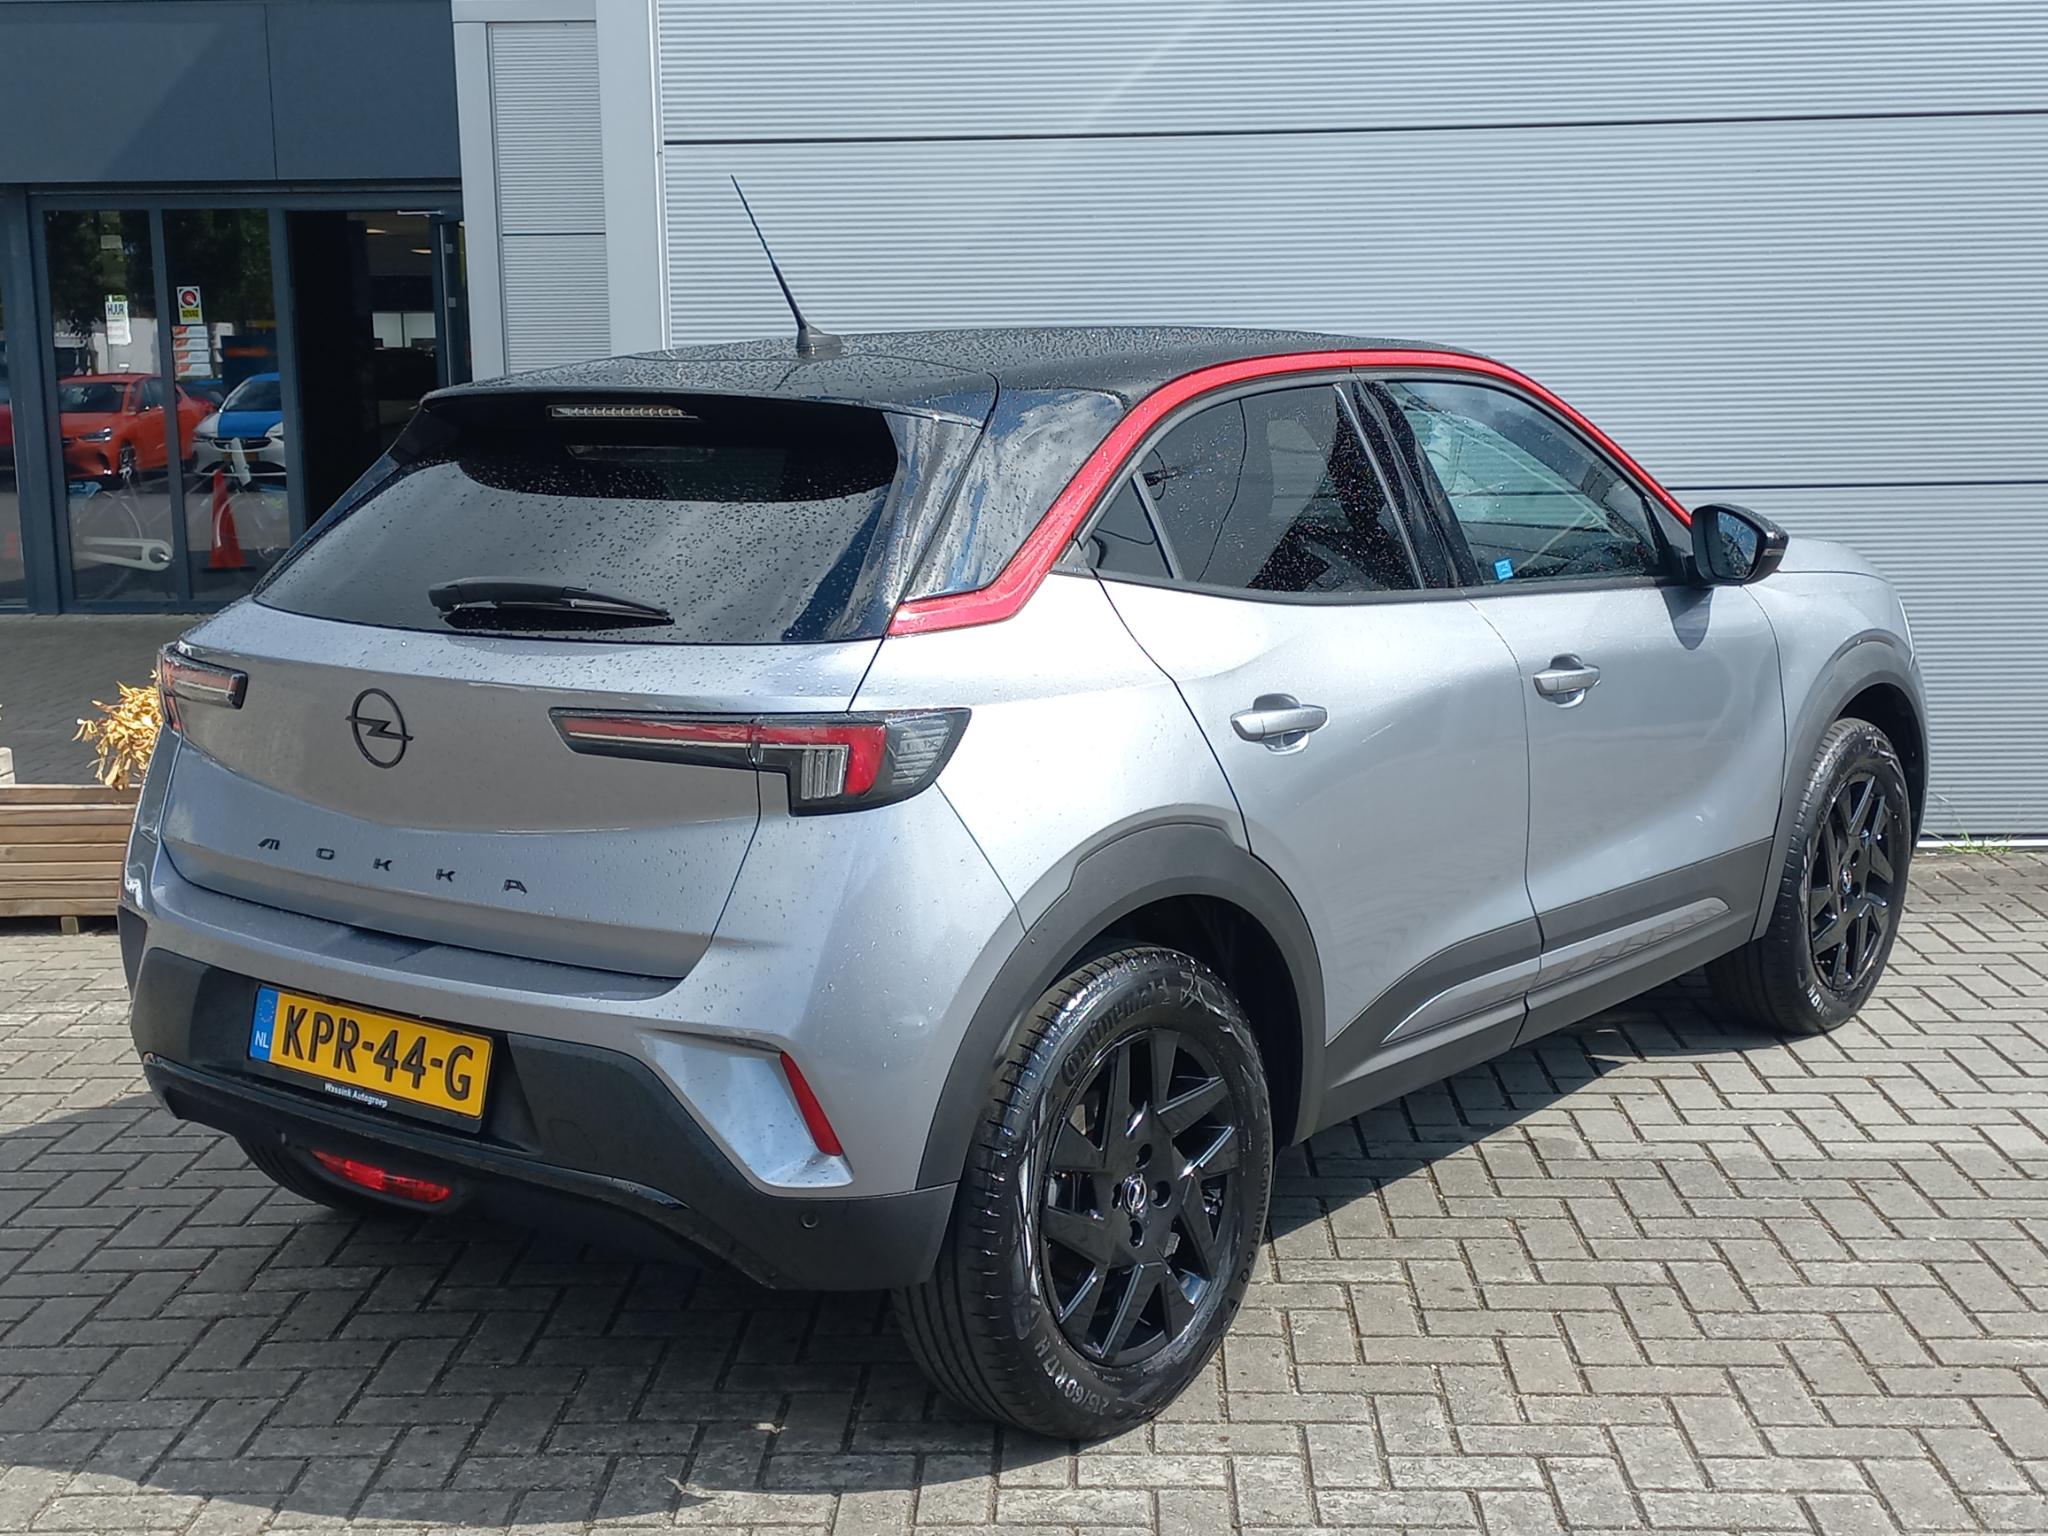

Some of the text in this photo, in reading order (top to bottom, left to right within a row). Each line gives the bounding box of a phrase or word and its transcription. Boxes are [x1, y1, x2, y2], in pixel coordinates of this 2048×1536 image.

[258, 837, 528, 894] MOKKA
[254, 1030, 270, 1049] NL
[281, 1004, 474, 1101] KPR-44-G
[324, 1081, 388, 1109] Wassink Autogroep
